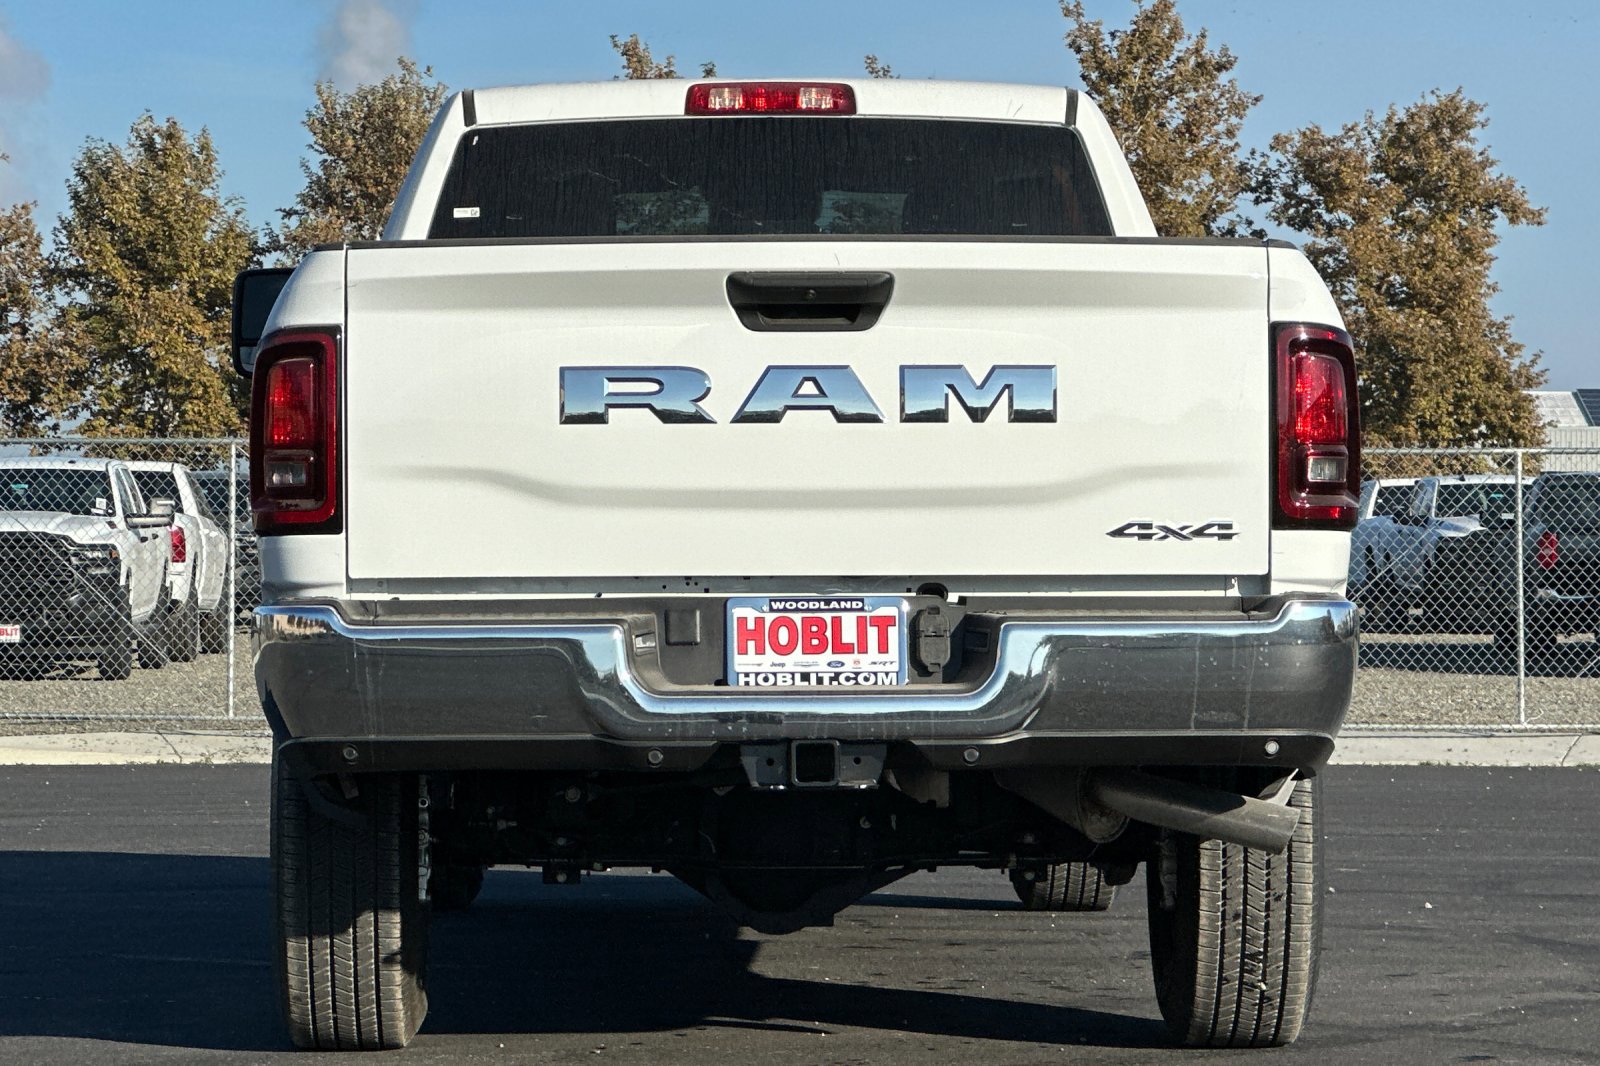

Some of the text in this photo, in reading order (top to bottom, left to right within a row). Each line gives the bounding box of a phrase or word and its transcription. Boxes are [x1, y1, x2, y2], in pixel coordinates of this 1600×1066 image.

[560, 365, 1057, 424] RAM
[770, 600, 863, 610] WOODLAND
[736, 615, 897, 656] HOBLIT
[738, 672, 897, 686] HOBLIT.COM
